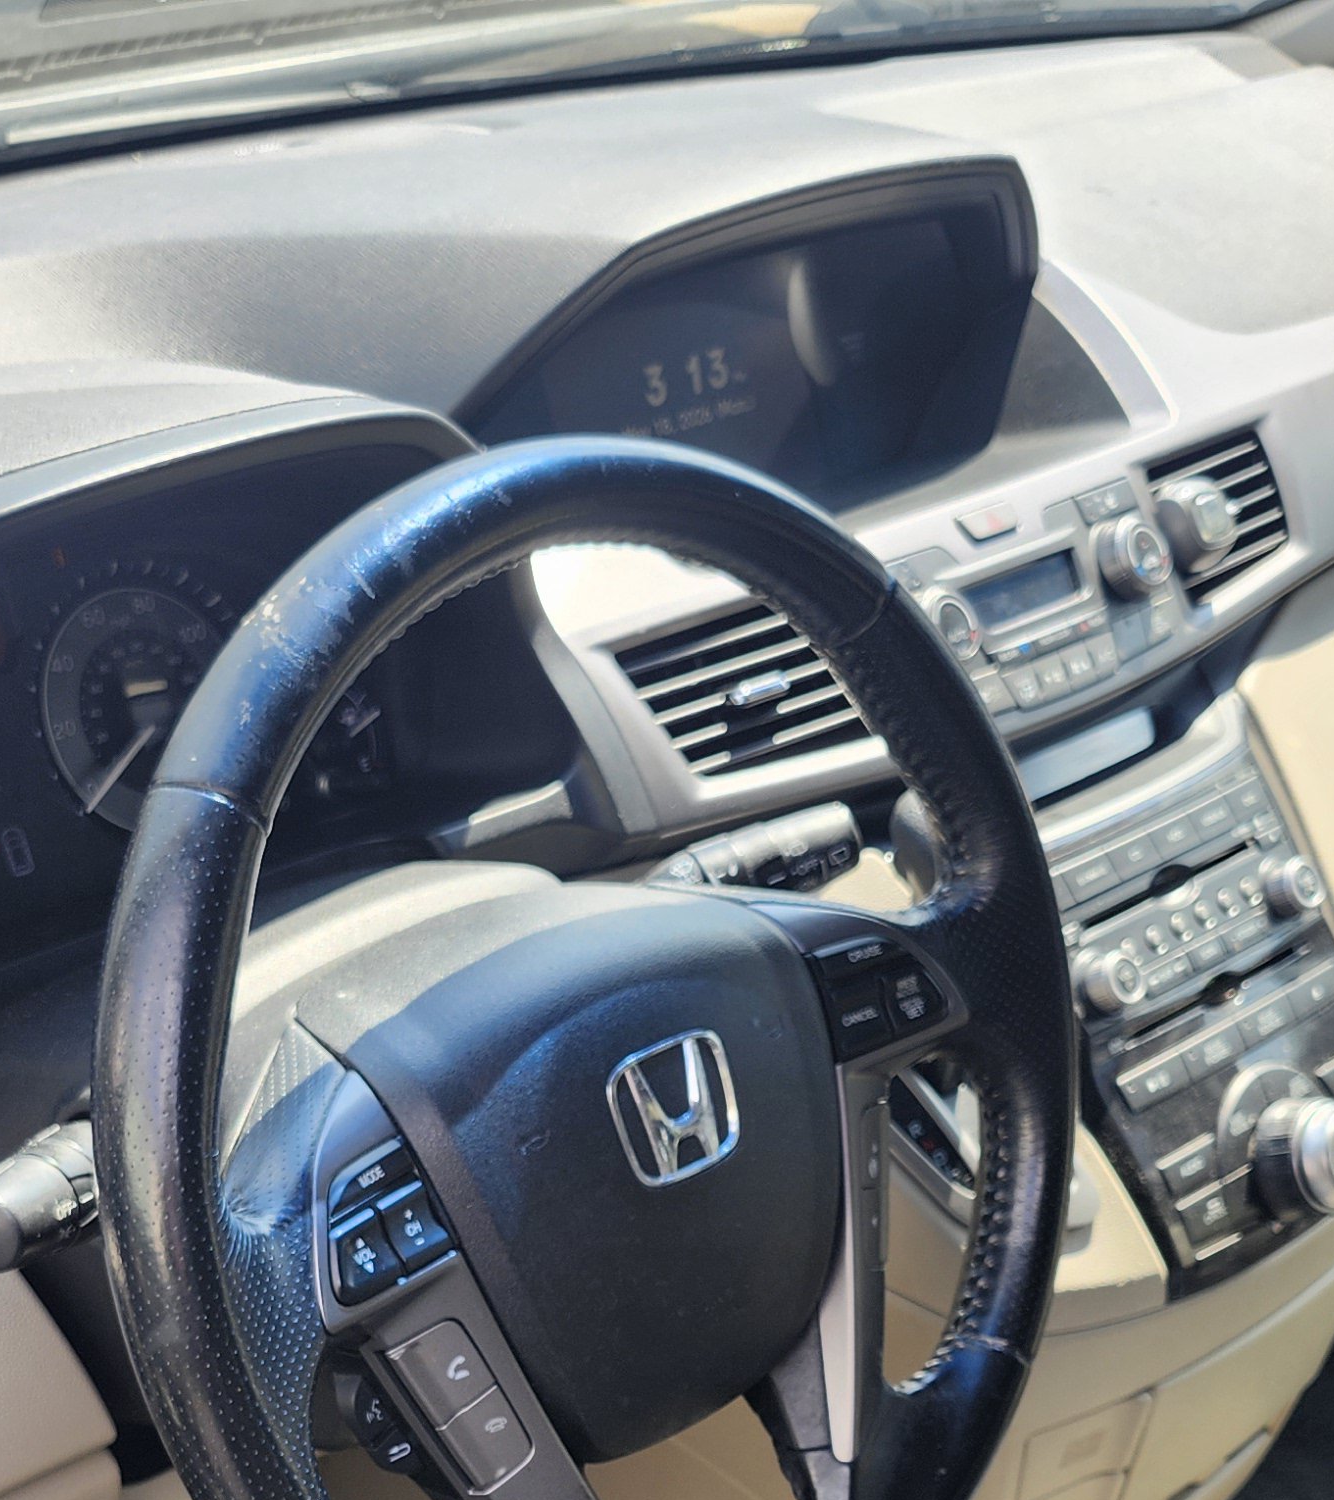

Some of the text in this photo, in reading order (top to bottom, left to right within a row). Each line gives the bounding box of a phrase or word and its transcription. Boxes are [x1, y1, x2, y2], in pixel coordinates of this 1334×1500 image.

[847, 944, 884, 963] CRUISE
[841, 1005, 879, 1027] CANCEL
[357, 1163, 386, 1189] MODE
[352, 1246, 377, 1266] VOL
